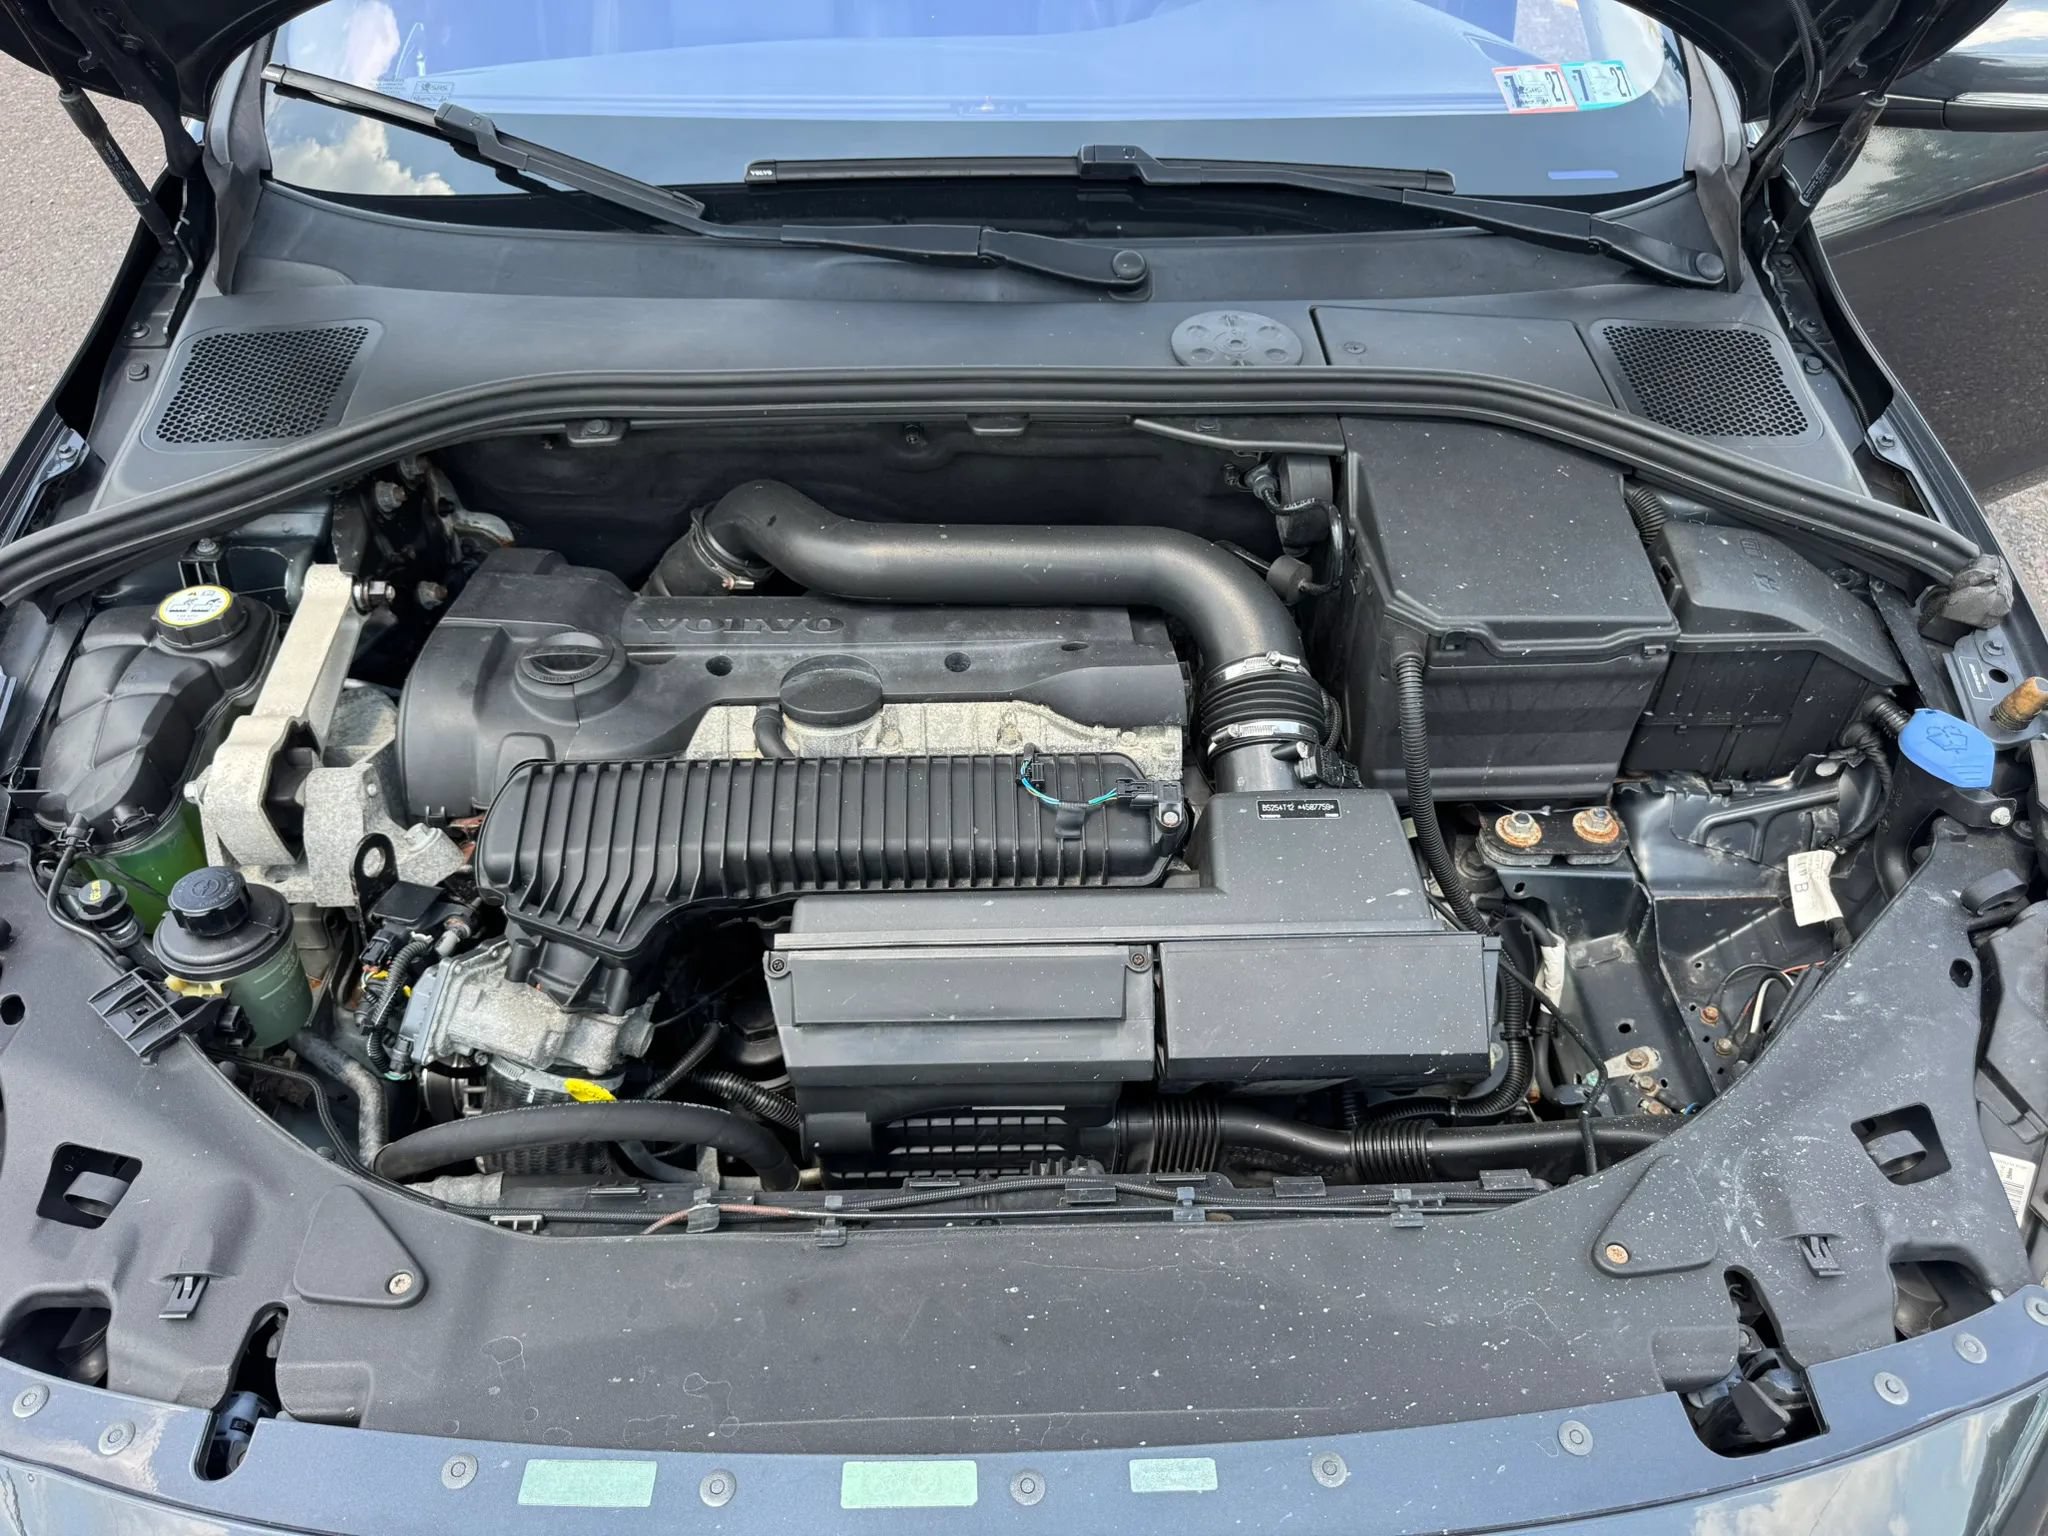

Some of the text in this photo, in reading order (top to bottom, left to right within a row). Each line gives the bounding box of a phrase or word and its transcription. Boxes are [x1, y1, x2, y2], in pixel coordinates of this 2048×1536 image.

[1544, 70, 1568, 105] 27
[1609, 66, 1632, 98] 27
[635, 617, 845, 634] VOLVO
